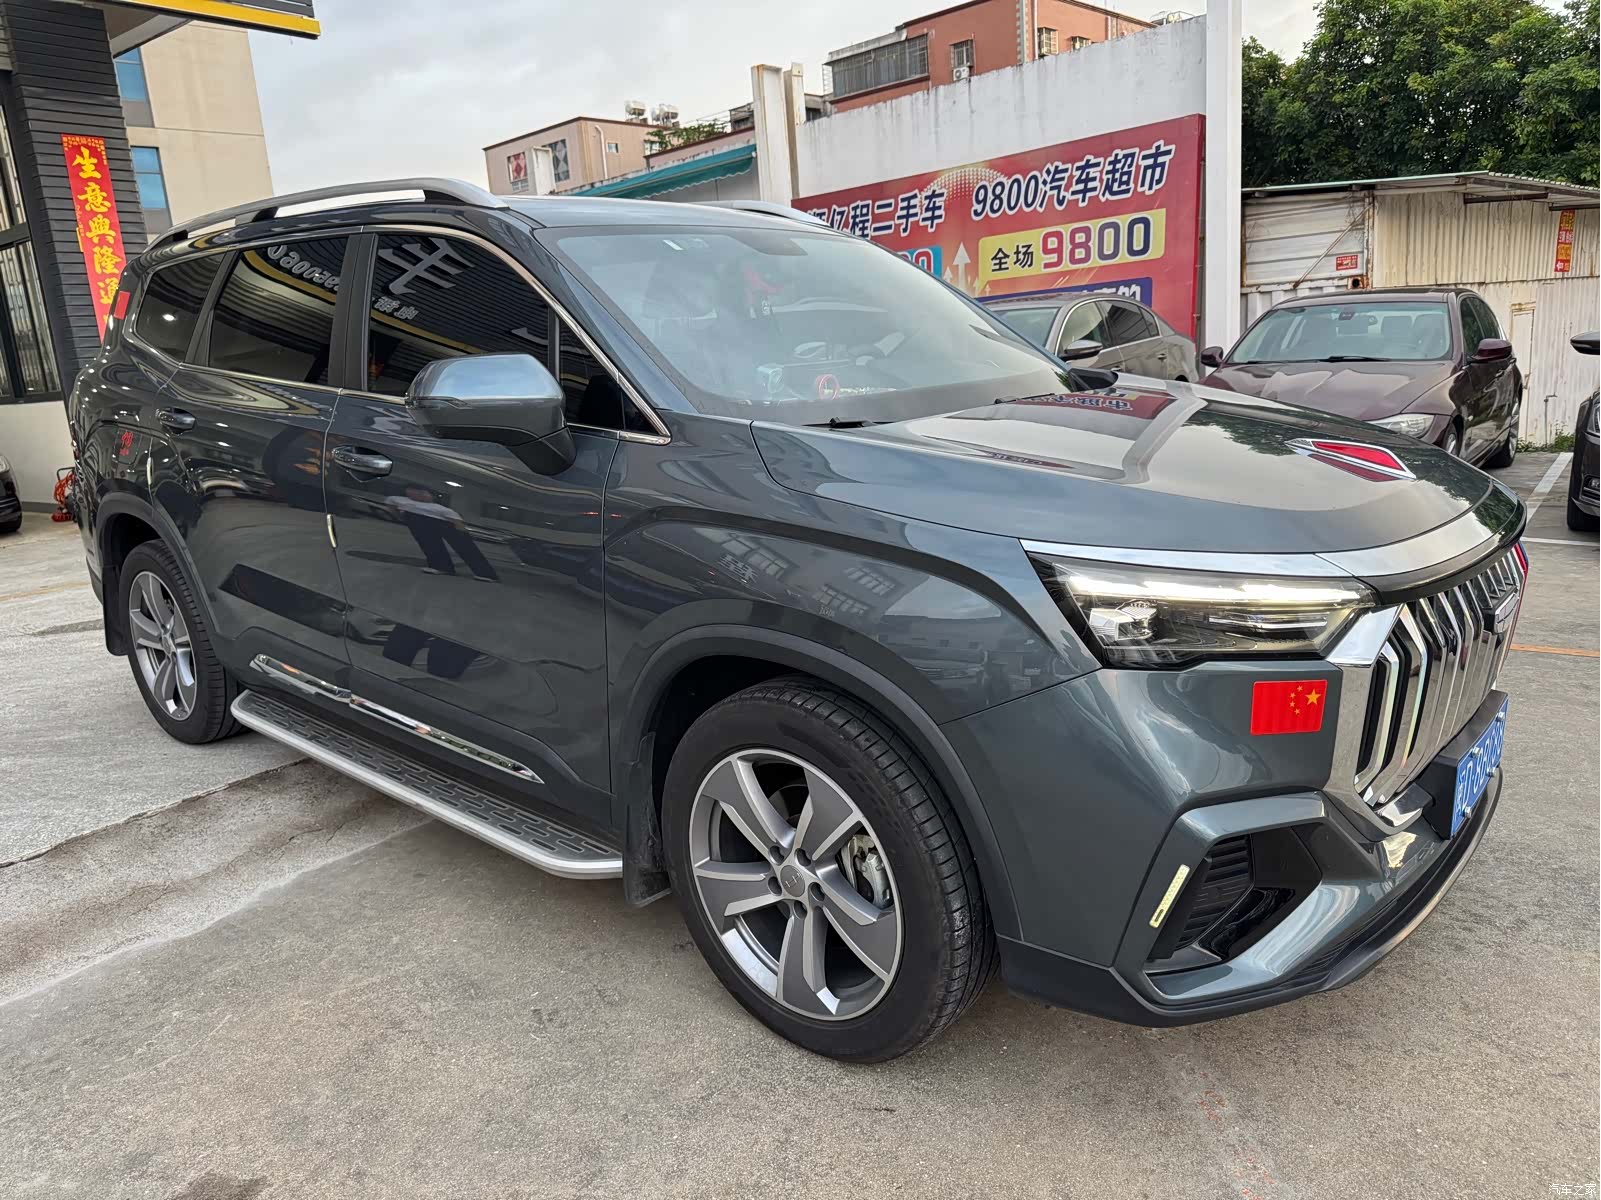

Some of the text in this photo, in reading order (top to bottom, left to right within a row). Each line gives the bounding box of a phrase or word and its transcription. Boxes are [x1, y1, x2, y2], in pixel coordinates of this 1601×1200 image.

[971, 139, 1175, 220] 9800汽车超市
[72, 146, 124, 322] 生意興隆通
[990, 213, 1152, 273] 全场 9800
